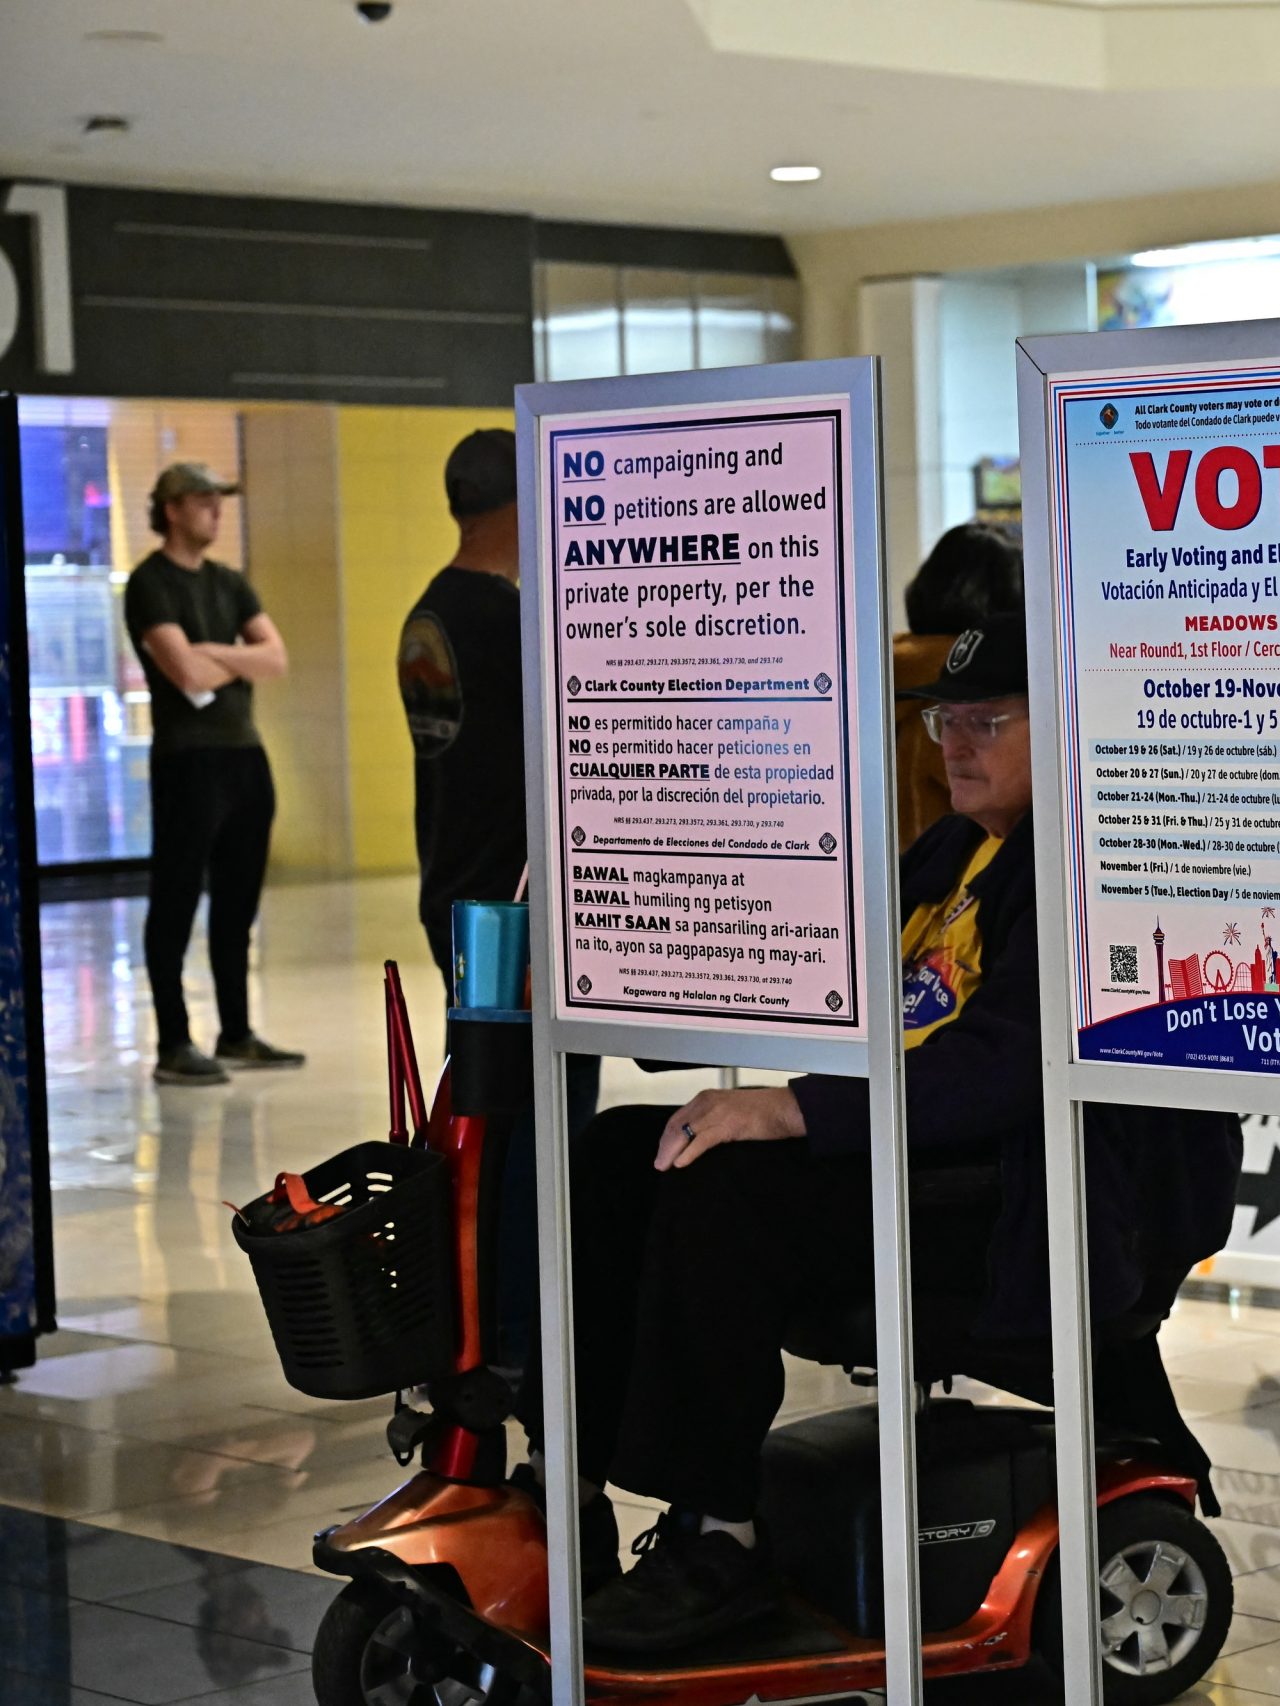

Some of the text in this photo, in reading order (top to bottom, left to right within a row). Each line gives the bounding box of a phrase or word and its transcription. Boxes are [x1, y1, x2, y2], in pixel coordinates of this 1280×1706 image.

[1134, 404, 1147, 415] All
[1147, 403, 1169, 415] Clark
[1169, 402, 1198, 414] County
[1198, 401, 1225, 411] voters
[1225, 401, 1243, 411] may
[1243, 398, 1262, 408] vote
[1263, 399, 1273, 408] or
[563, 441, 783, 479] NO campaigning and
[564, 486, 826, 526] NO petitions are allowed
[564, 532, 819, 567] ANYWHERE on this
[1126, 547, 1168, 573] Early
[1171, 545, 1227, 571] Voting
[1231, 543, 1263, 565] and
[565, 574, 814, 611] private property, per the
[1101, 579, 1164, 601] Votación
[1168, 577, 1248, 604] Anticipada
[1251, 582, 1260, 603] y
[1264, 576, 1278, 597] El
[646, 614, 686, 638] sole
[695, 612, 806, 637] discretion.
[1185, 614, 1278, 632] MEADOWS
[1109, 643, 1137, 659] Near
[1140, 641, 1187, 660] Round1,
[1190, 642, 1209, 658] 1st
[1211, 640, 1242, 658] Floor
[1244, 640, 1250, 657] /
[584, 678, 809, 695] Clark County Election Department
[1143, 677, 1211, 698] October
[568, 714, 791, 734] NO es permitido hacer campaña y
[1137, 709, 1155, 729] 19
[1158, 708, 1177, 729] de
[1180, 708, 1253, 729] octubre-1
[1256, 713, 1265, 735] y
[1269, 709, 1278, 729] 5
[569, 738, 811, 759] NO es permitido hacer peticiones en
[569, 762, 834, 784] CUALQUIER PARTE de esta propiedad
[570, 785, 825, 809] privada, por la discreción del propietario.
[593, 834, 810, 850] Departamento de Elecciones del Condado de Clark
[572, 865, 745, 889] BAWAL magkampanya at
[1100, 860, 1142, 872] November
[1143, 862, 1149, 872] 1
[1149, 861, 1169, 874] (Fri.)
[1169, 862, 1174, 873] /
[1174, 863, 1180, 873] 1
[1180, 862, 1191, 874] de
[1192, 863, 1232, 875] noviembre
[1232, 863, 1251, 877] (vie.)
[573, 888, 772, 915] BAWAL humiling ng petisyon
[574, 911, 839, 940] KAHIT SAAN sa pansariling ari-ariaan
[575, 935, 826, 966] na ito, ayon sa pagpapasya ng may-ari.
[623, 985, 790, 1008] Kagawara ng Halalan ng Clark County
[1165, 997, 1219, 1037] Don't
[1222, 996, 1269, 1025] Lose
